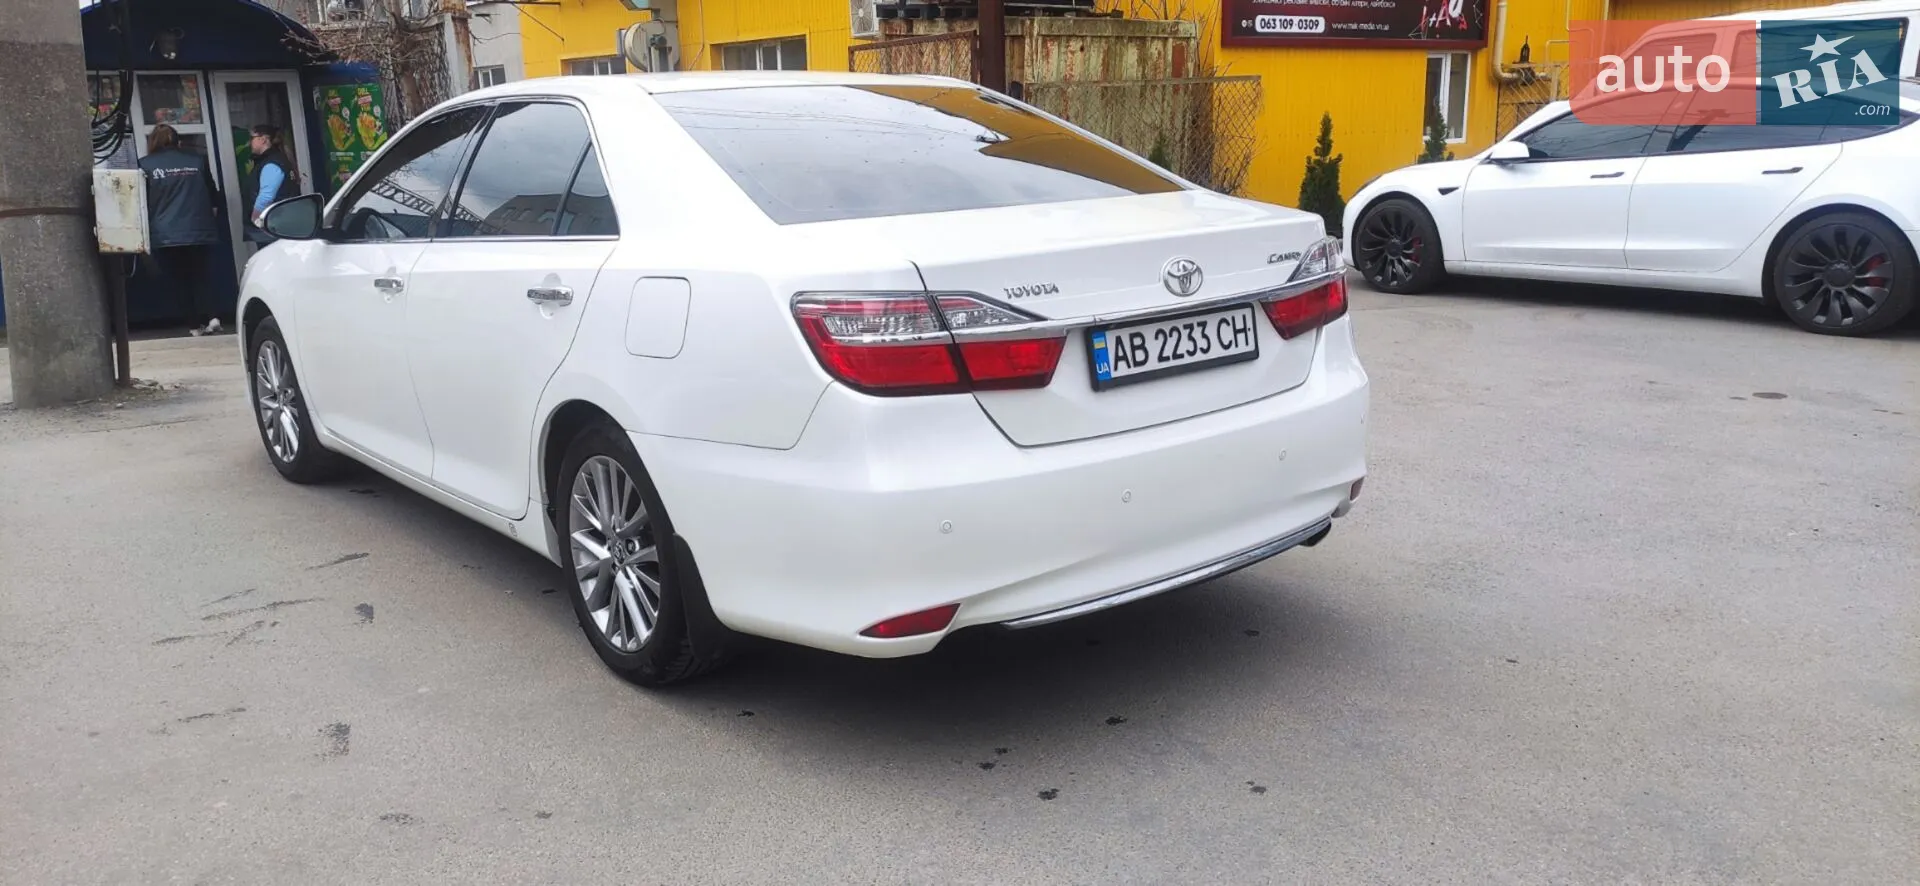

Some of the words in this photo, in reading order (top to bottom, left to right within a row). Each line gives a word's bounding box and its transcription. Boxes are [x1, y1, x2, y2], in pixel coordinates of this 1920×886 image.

[1260, 18, 1277, 30] 063
[1003, 283, 1059, 299] TOYOTA
[1113, 331, 1149, 372] AB
[1154, 320, 1212, 364] 2233
[1216, 313, 1250, 351] CH
[1096, 361, 1110, 374] UA
